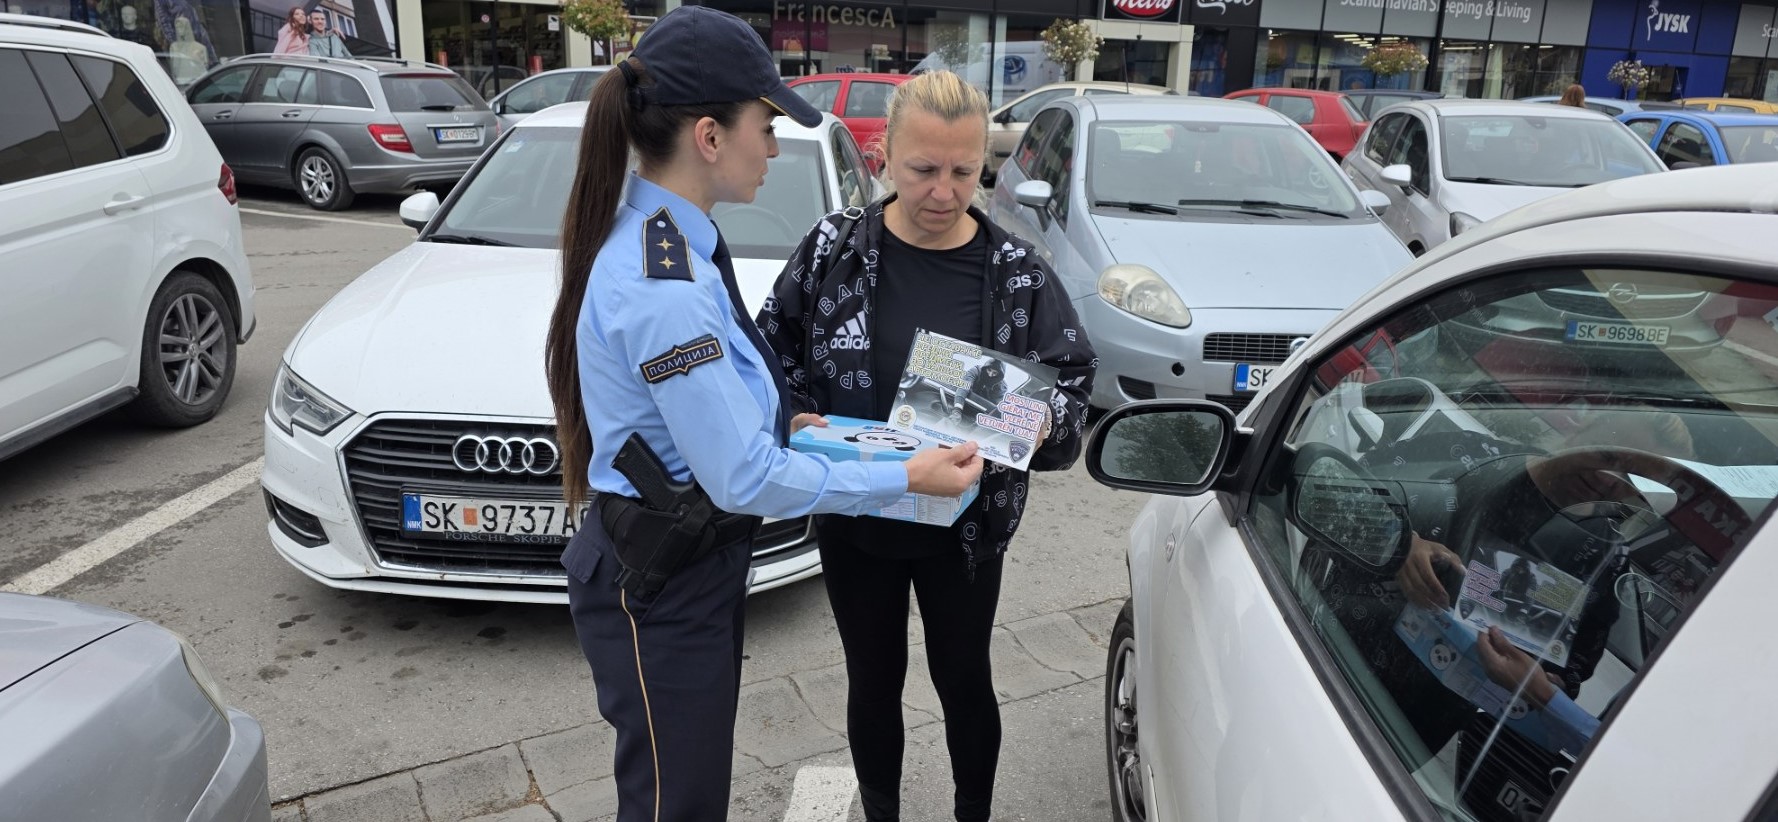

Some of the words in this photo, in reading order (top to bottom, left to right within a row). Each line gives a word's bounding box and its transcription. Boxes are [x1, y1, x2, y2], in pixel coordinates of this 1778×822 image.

[1485, 0, 1495, 16] &
[1496, 1, 1531, 23] Living
[1654, 12, 1690, 33] JYSK
[1577, 324, 1597, 339] SK
[830, 334, 870, 350] adid
[648, 346, 716, 376] ПОЛИЦИЈА
[1250, 368, 1273, 387] SK
[407, 521, 422, 529] NMK
[424, 501, 459, 531] SK
[444, 530, 508, 543] PORSCHE
[513, 534, 562, 545] SKOPJE
